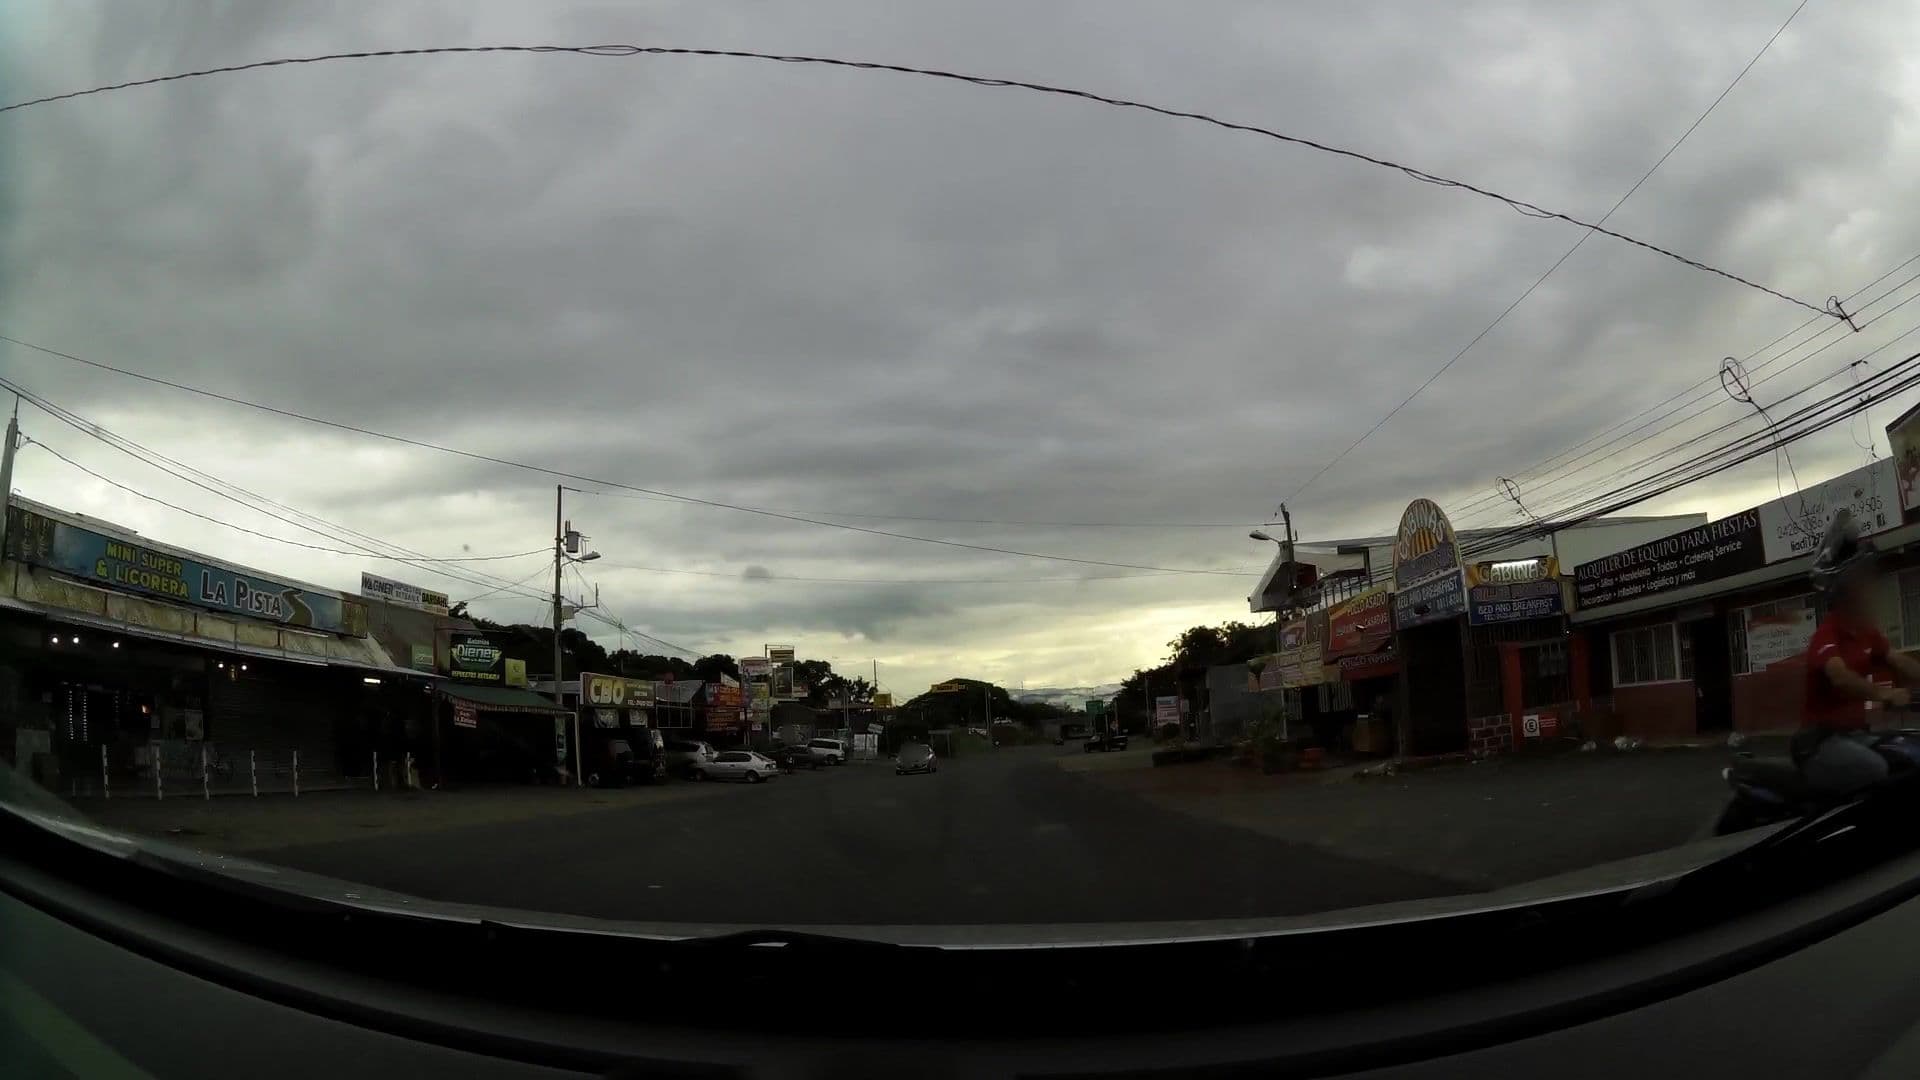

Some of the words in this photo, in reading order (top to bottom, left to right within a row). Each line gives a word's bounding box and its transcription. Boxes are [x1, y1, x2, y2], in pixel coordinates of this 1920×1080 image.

[1398, 501, 1446, 561] CABINAS
[1578, 554, 1622, 580] ALQUILER
[1623, 551, 1637, 567] DE
[1638, 538, 1679, 562] EQUIPO
[1681, 528, 1710, 551] PARA
[1711, 511, 1757, 541] FIESTAS
[1684, 549, 1713, 565] Catering
[1715, 539, 1743, 557] Service
[106, 542, 137, 562] MINI
[141, 552, 182, 577] SUPER
[1479, 559, 1550, 582] CABINAS
[95, 559, 108, 577] &
[115, 564, 189, 598] LICORERA
[362, 575, 394, 596] WAGNER
[1512, 599, 1553, 612] BREAKFAST
[590, 678, 624, 705] CBO
